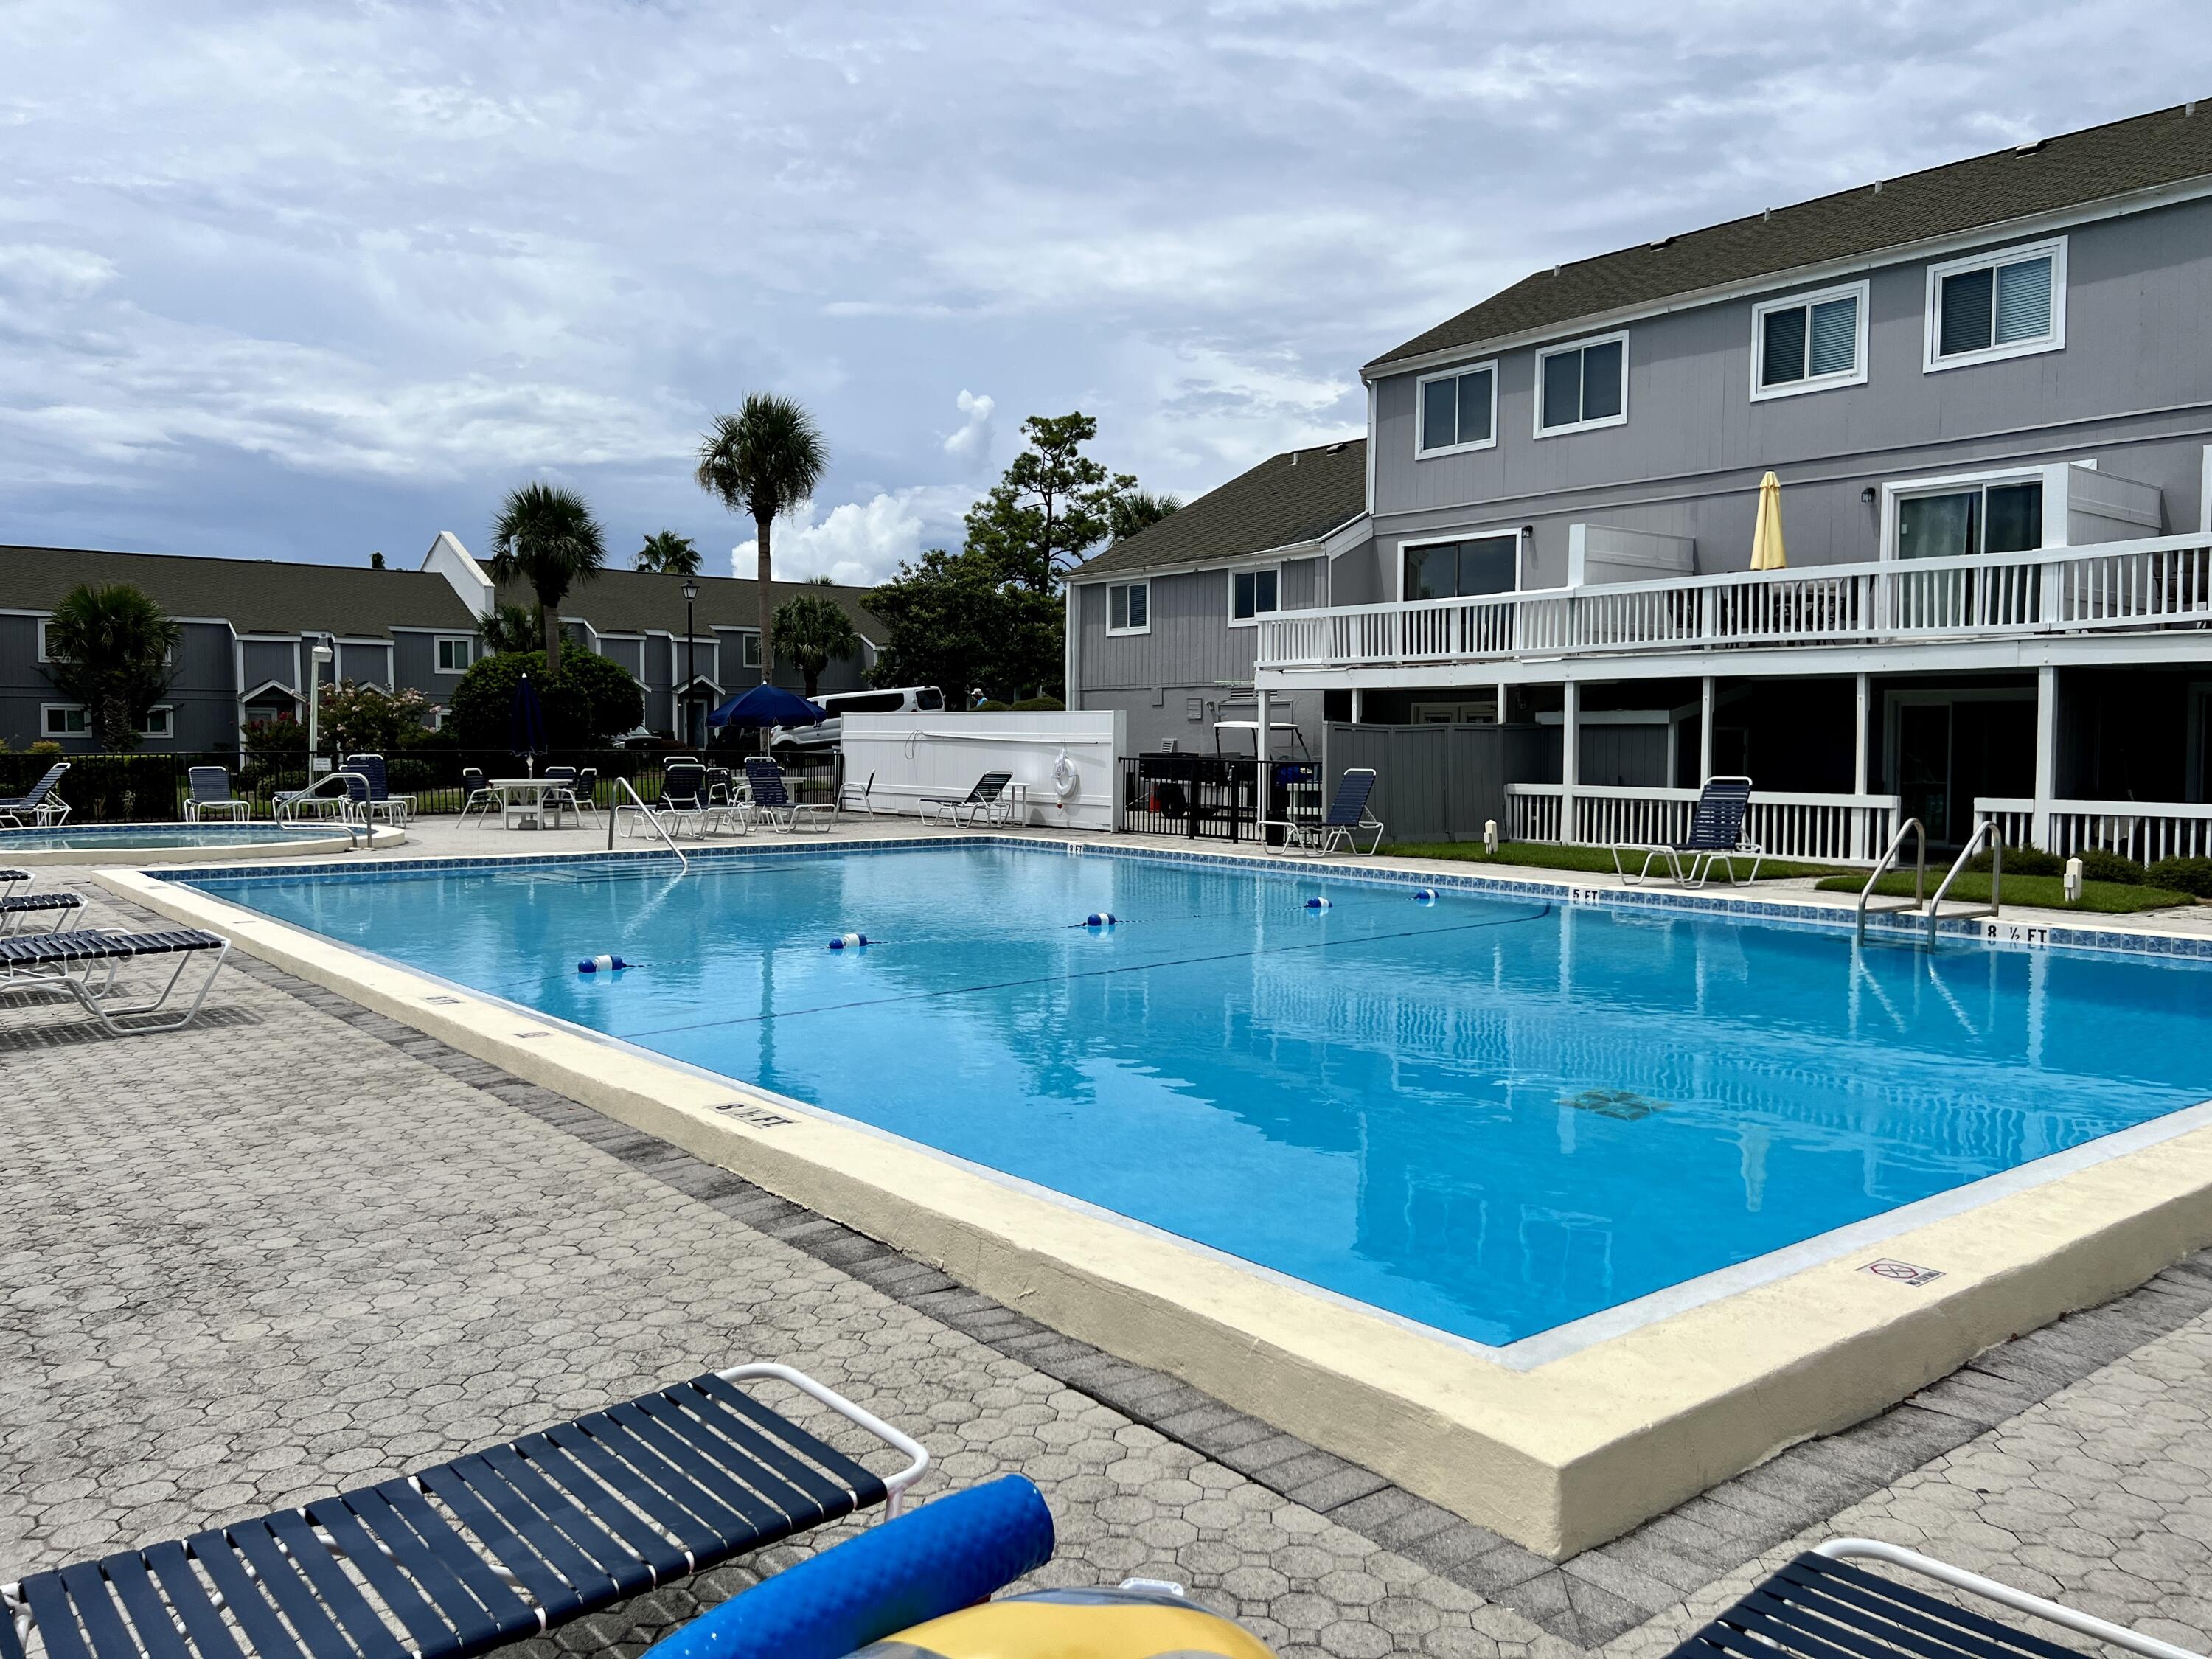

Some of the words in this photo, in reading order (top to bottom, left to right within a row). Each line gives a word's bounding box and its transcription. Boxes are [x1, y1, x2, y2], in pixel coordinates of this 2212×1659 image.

[1075, 845, 1083, 853] FT
[1573, 888, 1580, 898] 5
[1585, 890, 1598, 900] FT
[1987, 925, 1997, 938] 8
